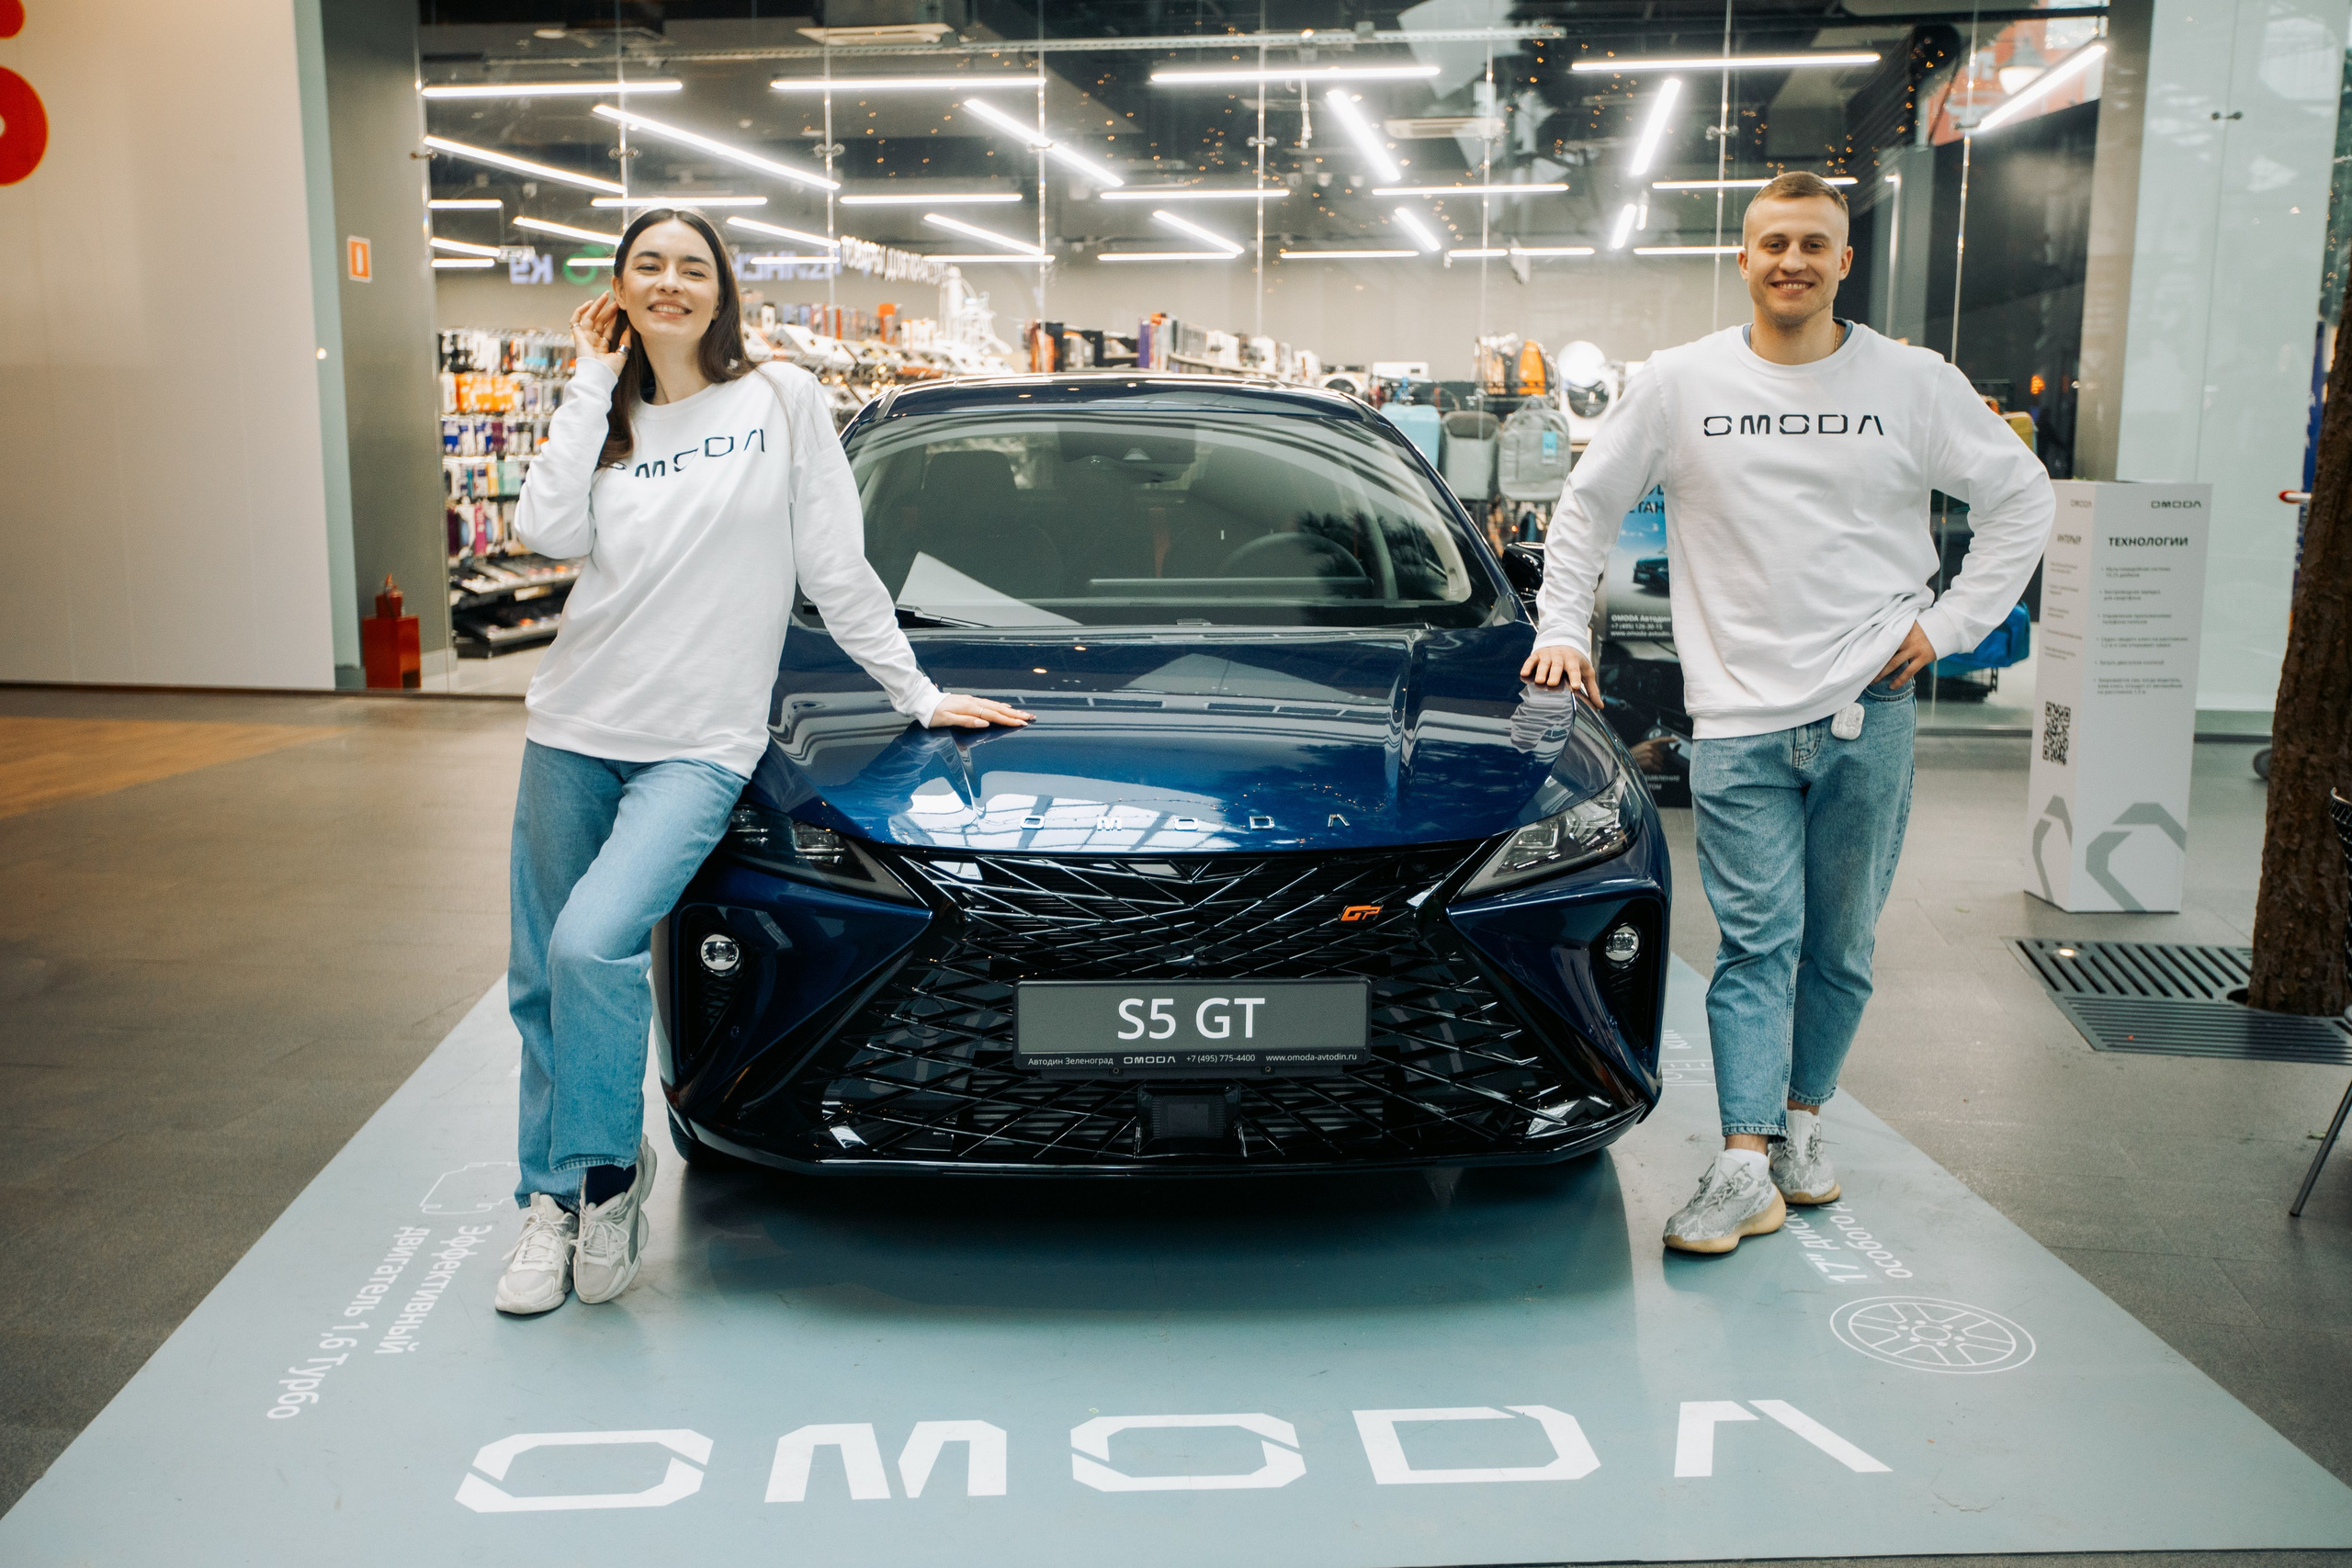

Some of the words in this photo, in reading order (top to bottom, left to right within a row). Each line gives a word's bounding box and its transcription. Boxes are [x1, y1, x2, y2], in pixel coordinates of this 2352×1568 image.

[1703, 413, 1884, 437] OMODA
[2150, 500, 2202, 509] OMODA
[2108, 536, 2188, 547] ТЕХНОЛОГИИ
[1611, 614, 1638, 622] OMODA
[1020, 813, 1351, 831] OMODA
[1117, 998, 1177, 1040] S5
[1195, 997, 1266, 1039] GT
[1027, 1057, 1064, 1066] Автодин
[1065, 1057, 1114, 1066] Зеленоград
[1123, 1056, 1176, 1065] OMODA
[1197, 1055, 1217, 1064] (495)
[1265, 1053, 1357, 1061] www.omoda-avtodin.ru
[1829, 1215, 1913, 1279] особого
[344, 1226, 431, 1316] двигатель
[374, 1224, 492, 1354] Эффективный
[319, 1321, 369, 1349] 1,6
[266, 1352, 349, 1419] Турбо
[454, 1399, 1894, 1513] OMODA
